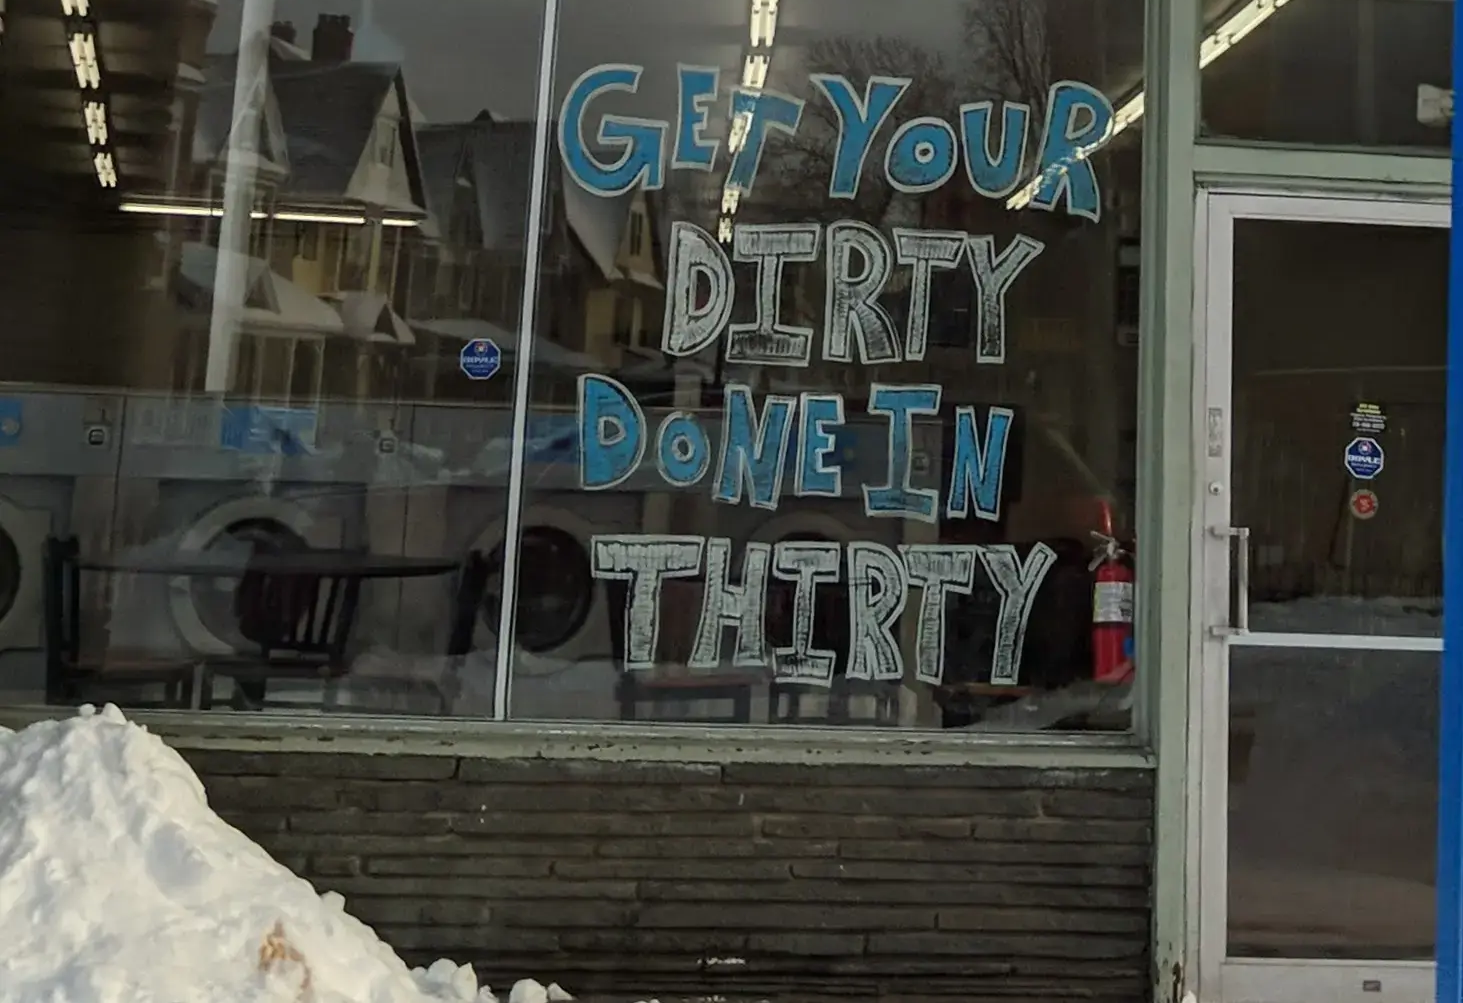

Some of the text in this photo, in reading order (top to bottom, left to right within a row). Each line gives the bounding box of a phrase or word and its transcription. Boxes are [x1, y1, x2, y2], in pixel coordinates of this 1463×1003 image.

[557, 62, 805, 198] GET
[660, 218, 1046, 367] DIRTY
[862, 382, 1015, 523] IN
[590, 533, 1059, 688] THIRTY
